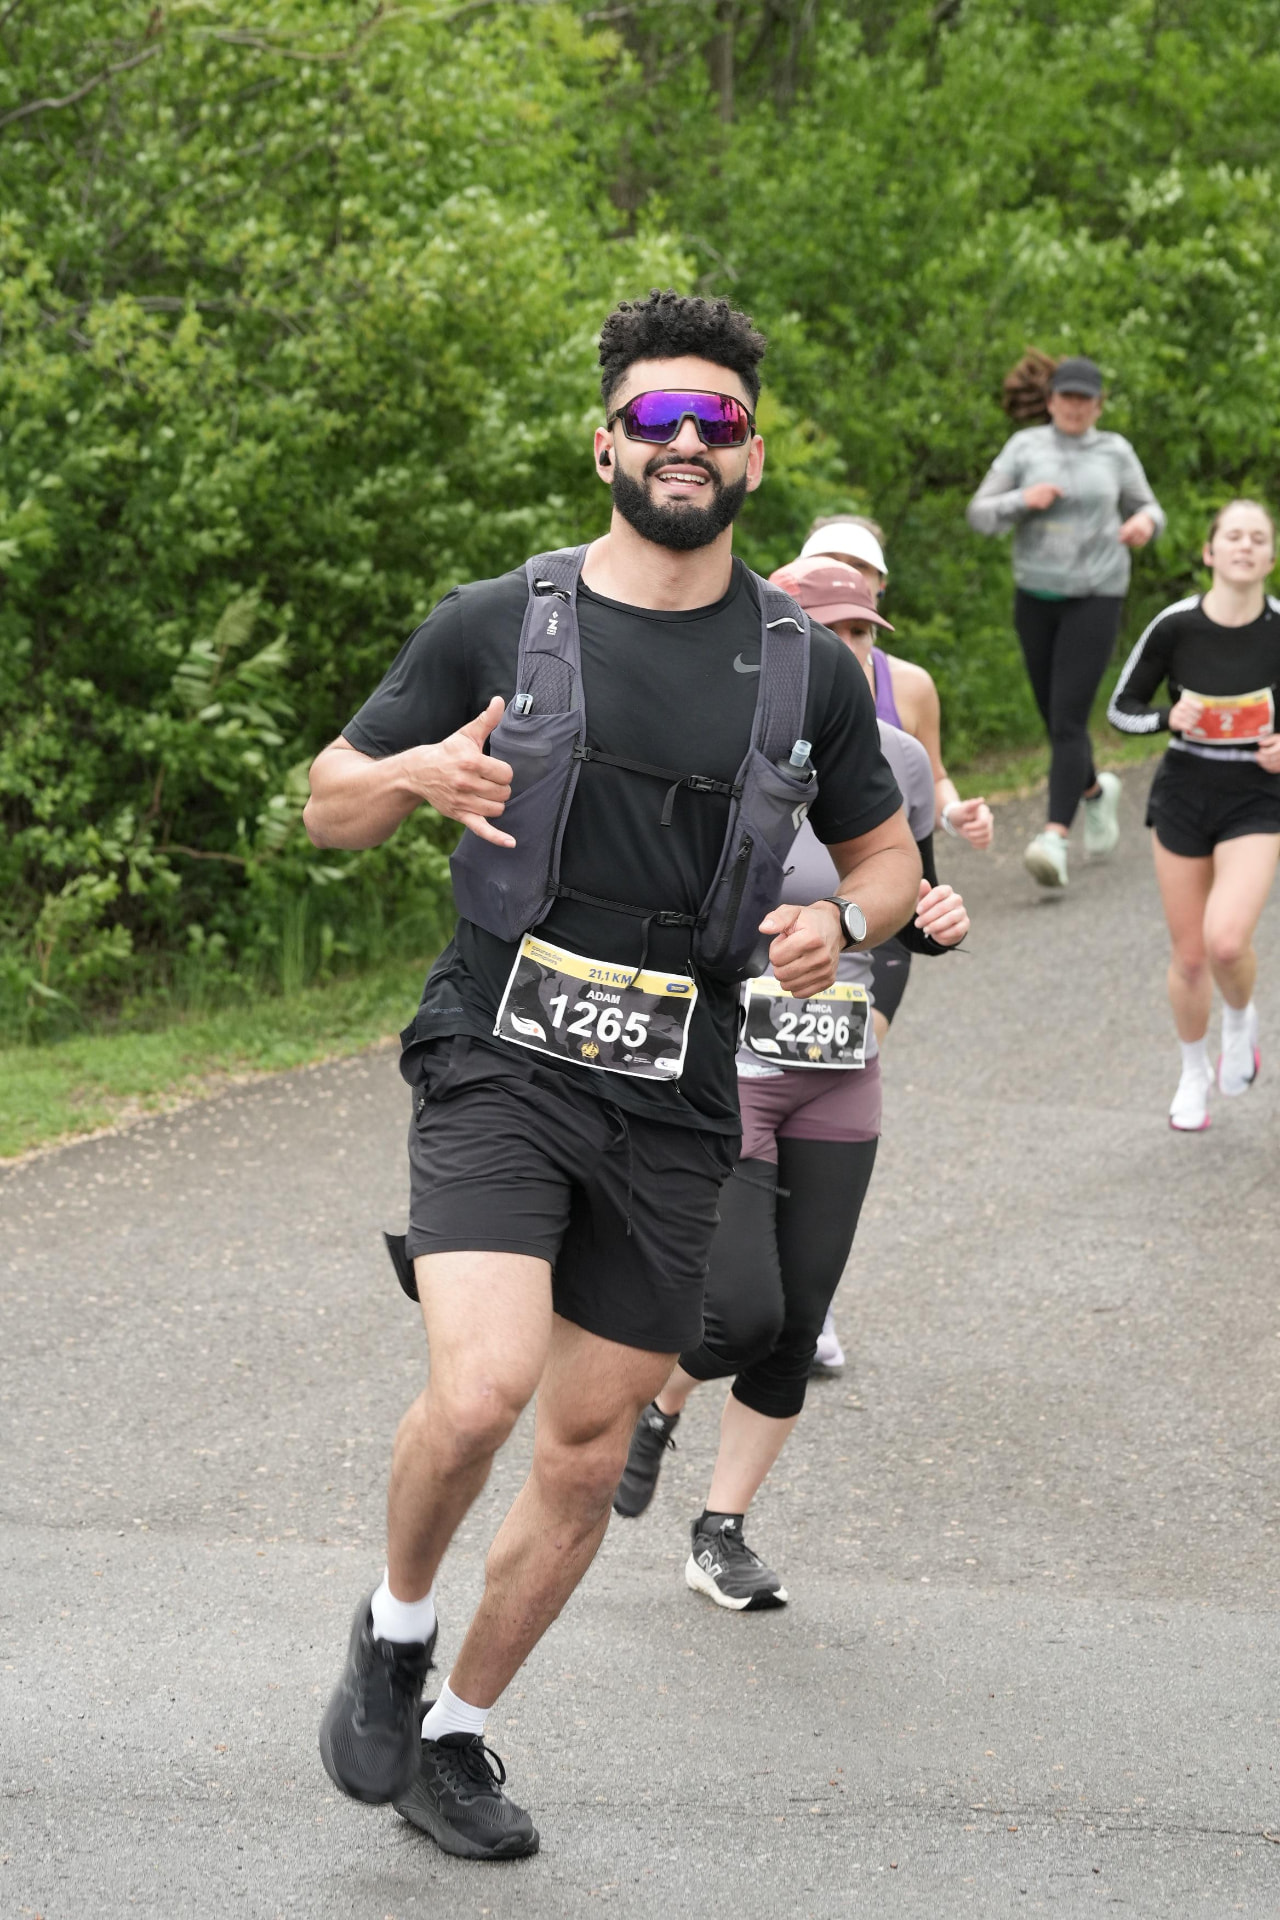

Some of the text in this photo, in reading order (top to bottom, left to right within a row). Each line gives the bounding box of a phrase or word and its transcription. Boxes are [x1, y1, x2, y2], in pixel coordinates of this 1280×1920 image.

[588, 968, 632, 985] 21,1 KM
[586, 989, 621, 1005] ADAM
[806, 1003, 832, 1014] MIRCA
[549, 993, 650, 1048] 1265
[775, 1012, 850, 1046] 2296
